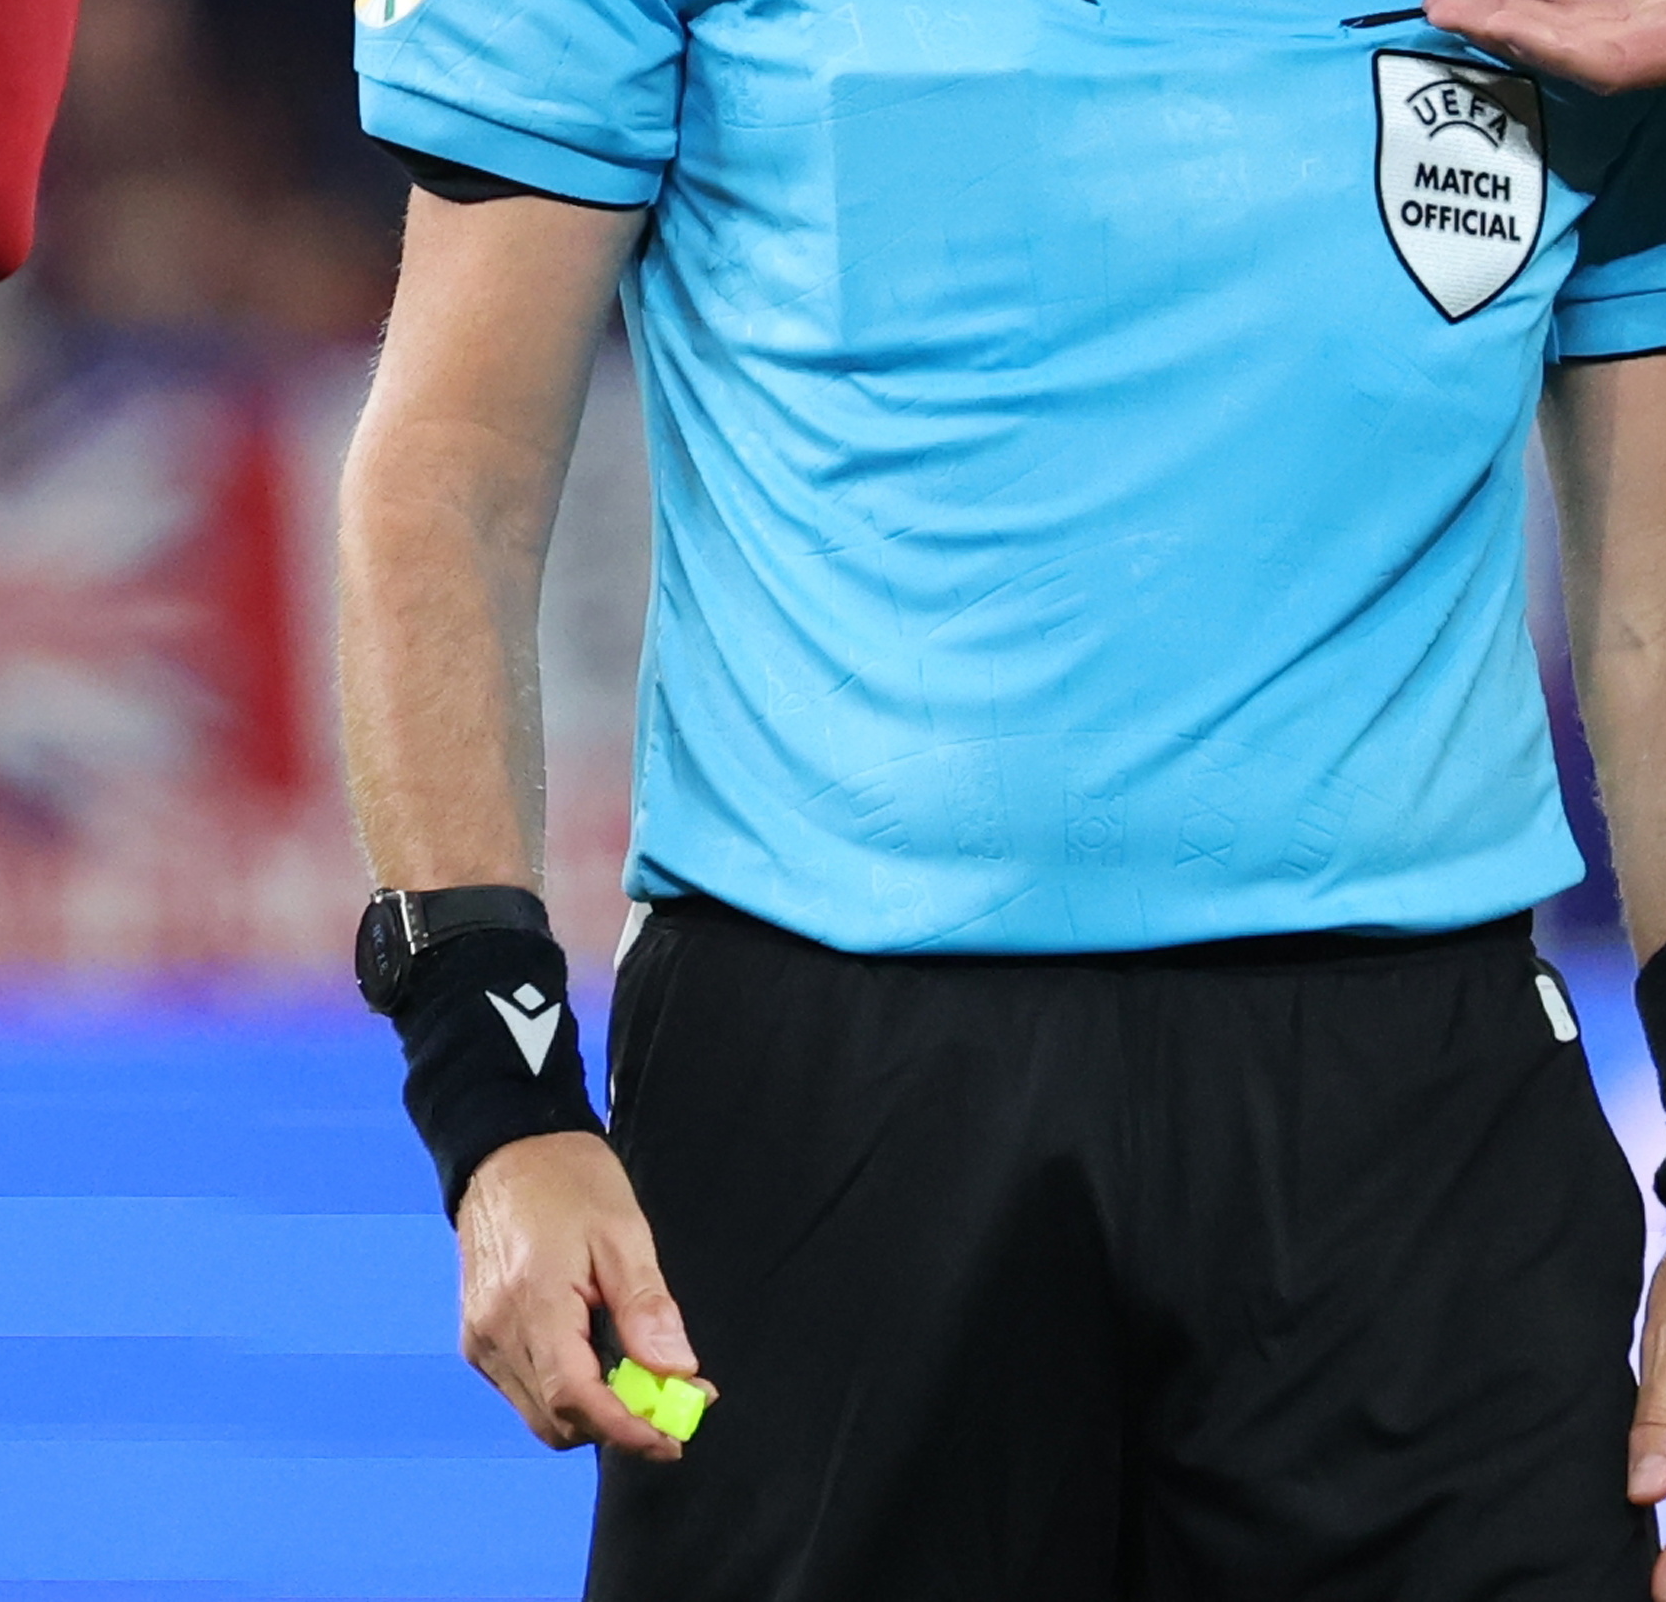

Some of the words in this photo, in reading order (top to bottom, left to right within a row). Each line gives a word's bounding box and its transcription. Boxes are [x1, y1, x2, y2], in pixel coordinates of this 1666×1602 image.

[1413, 89, 1508, 142] UEFA
[1414, 162, 1511, 202] MATCH
[1400, 200, 1521, 242] OFFICIAL
